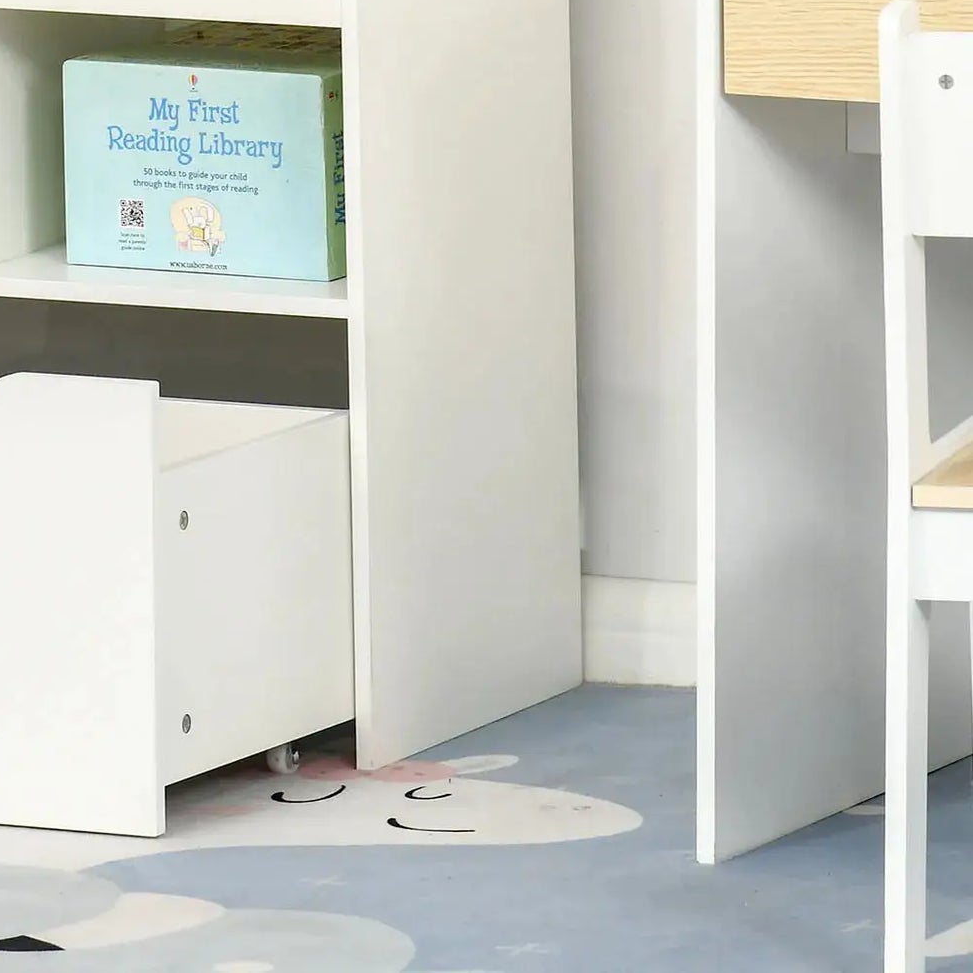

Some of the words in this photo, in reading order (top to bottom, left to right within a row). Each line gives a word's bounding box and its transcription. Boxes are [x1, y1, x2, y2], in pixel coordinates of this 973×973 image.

[148, 97, 180, 131] My
[188, 98, 240, 125] First
[107, 125, 193, 165] Reading
[199, 131, 284, 169] Library
[133, 178, 163, 190] through
[164, 180, 177, 189] the
[178, 181, 194, 190] first
[195, 182, 220, 193] stages
[221, 183, 229, 192] of
[230, 184, 259, 196] reading
[143, 167, 154, 176] 50
[154, 167, 177, 178] books
[178, 170, 187, 178] to
[188, 170, 209, 181] guide
[210, 172, 228, 182] your
[229, 172, 248, 182] child
